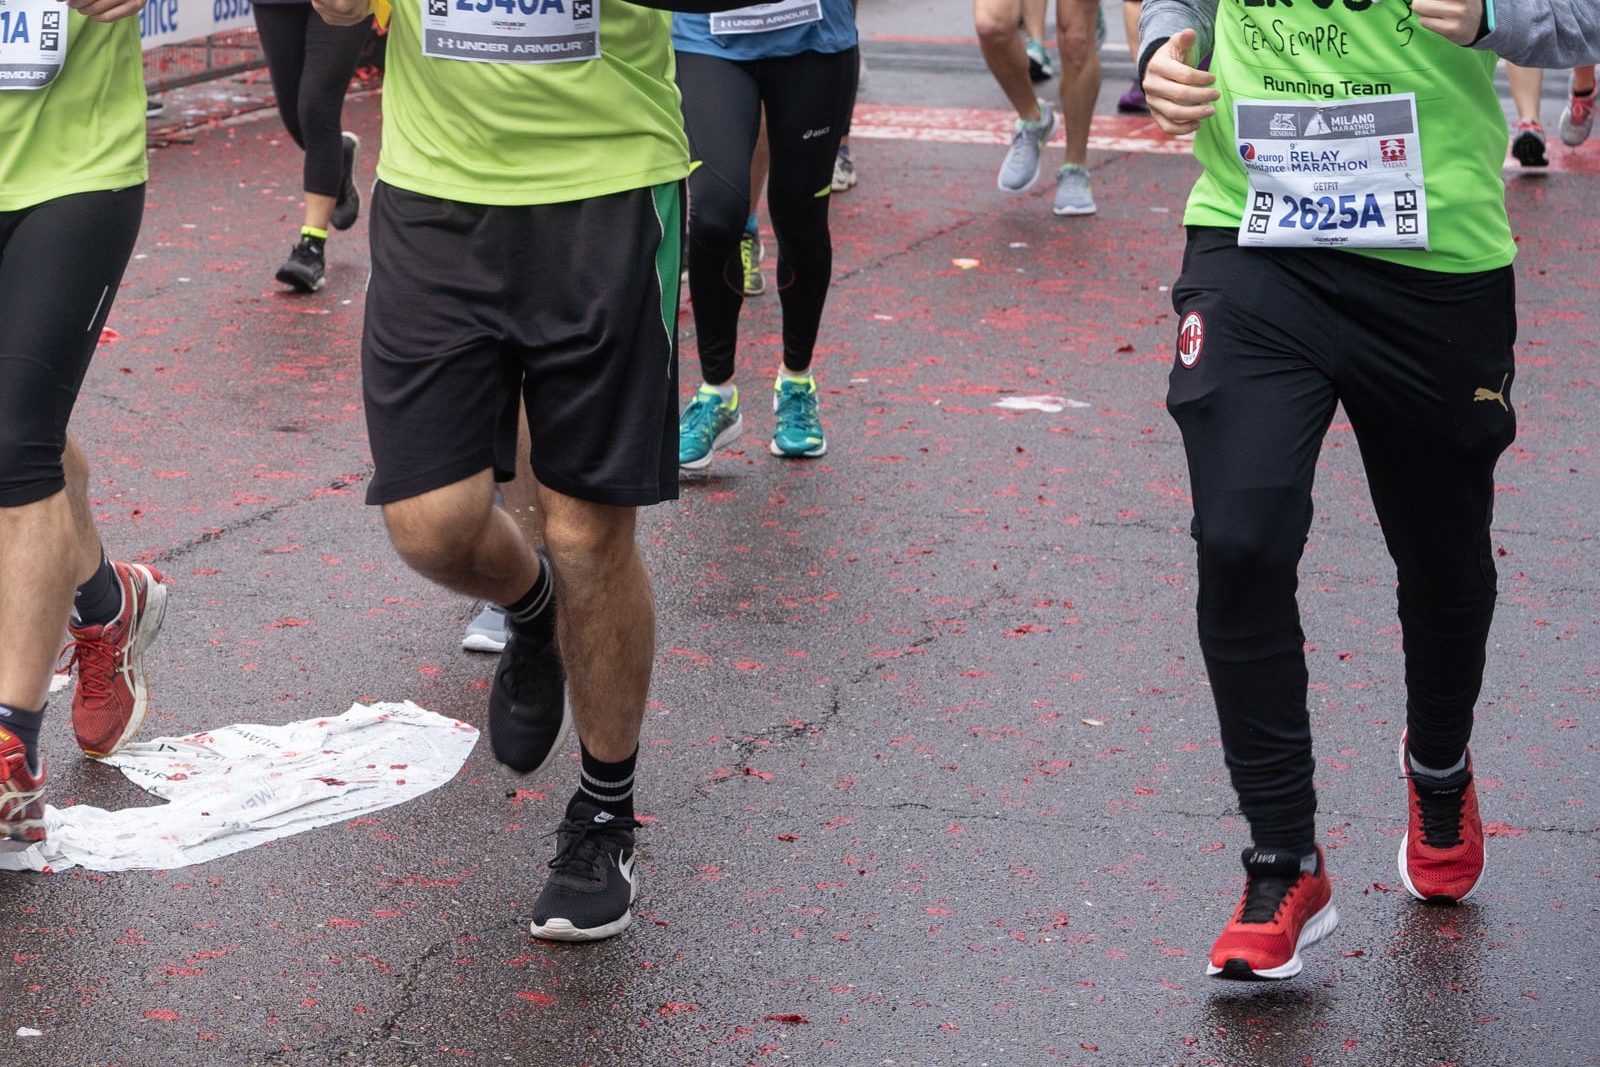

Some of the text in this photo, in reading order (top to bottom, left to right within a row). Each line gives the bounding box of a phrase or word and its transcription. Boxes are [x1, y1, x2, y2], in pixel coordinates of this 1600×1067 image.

[732, 9, 810, 27] UNDER ARMOUR
[456, 40, 582, 54] UNDER ARMOUR
[1263, 75, 1392, 99] Running Team
[1331, 114, 1375, 126] MILANO
[1269, 129, 1297, 137] GENERALI
[1331, 123, 1376, 133] MARATHON
[1257, 153, 1284, 164] europ
[1291, 150, 1340, 162] RELAY
[1291, 160, 1369, 173] MARATHON
[1382, 161, 1408, 169] VIDAS
[1313, 182, 1339, 191] GETFIT
[1278, 193, 1386, 231] 2625A
